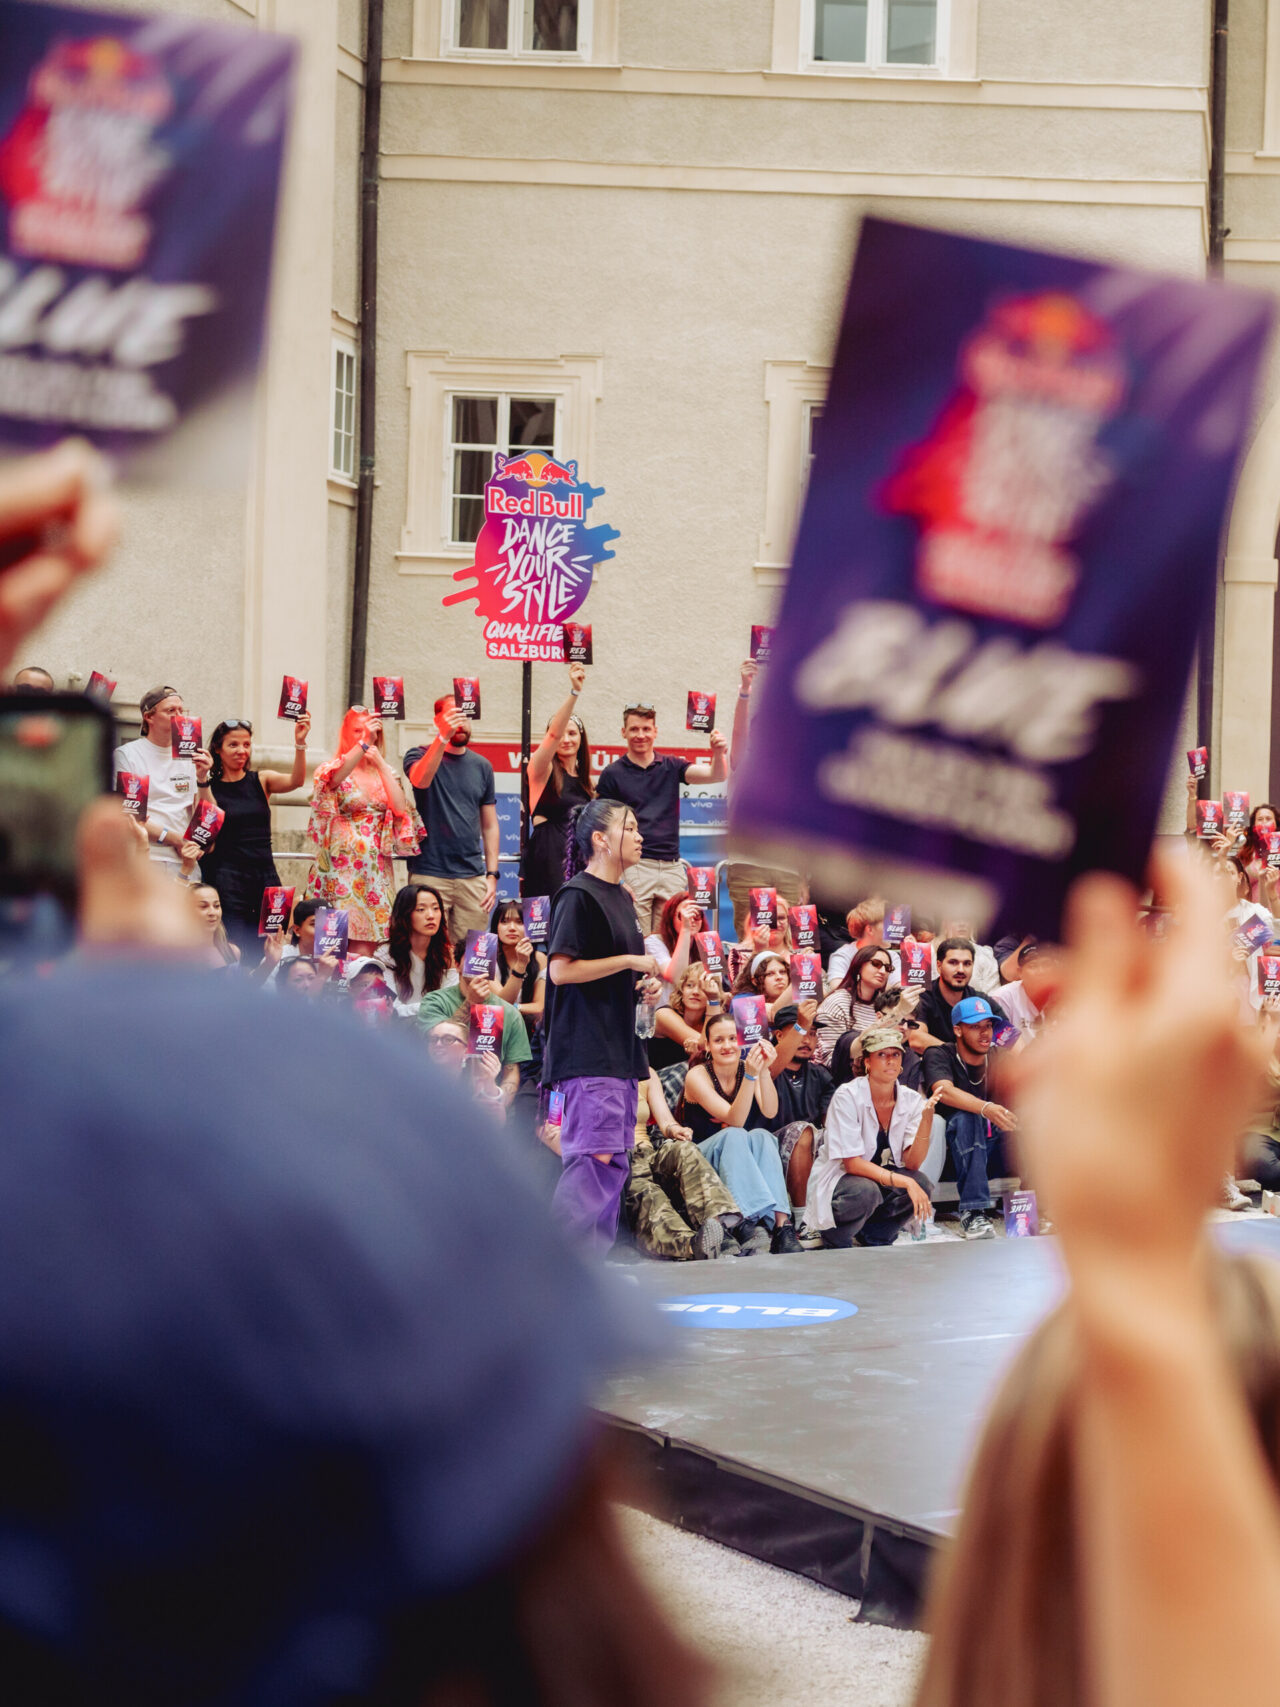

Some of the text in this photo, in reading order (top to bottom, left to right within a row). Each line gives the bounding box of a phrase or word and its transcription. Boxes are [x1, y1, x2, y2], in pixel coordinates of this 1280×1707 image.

[0, 255, 217, 367] LUE
[489, 488, 583, 518] Red Bull
[499, 518, 576, 554] DANCE
[505, 544, 583, 585] YOUR
[500, 570, 579, 621] STYLE
[486, 621, 564, 643] QUALIFIE
[286, 702, 301, 710] RED
[179, 741, 196, 749] RED
[195, 827, 211, 837] RED
[266, 915, 284, 923] RED
[528, 921, 547, 930] BLUE
[798, 931, 814, 939] RED
[319, 937, 343, 946] BLUE
[469, 957, 491, 967] BLUE
[908, 969, 925, 977] RED
[799, 982, 816, 990] RED
[744, 1025, 761, 1034] RED
[476, 1035, 495, 1044] RED
